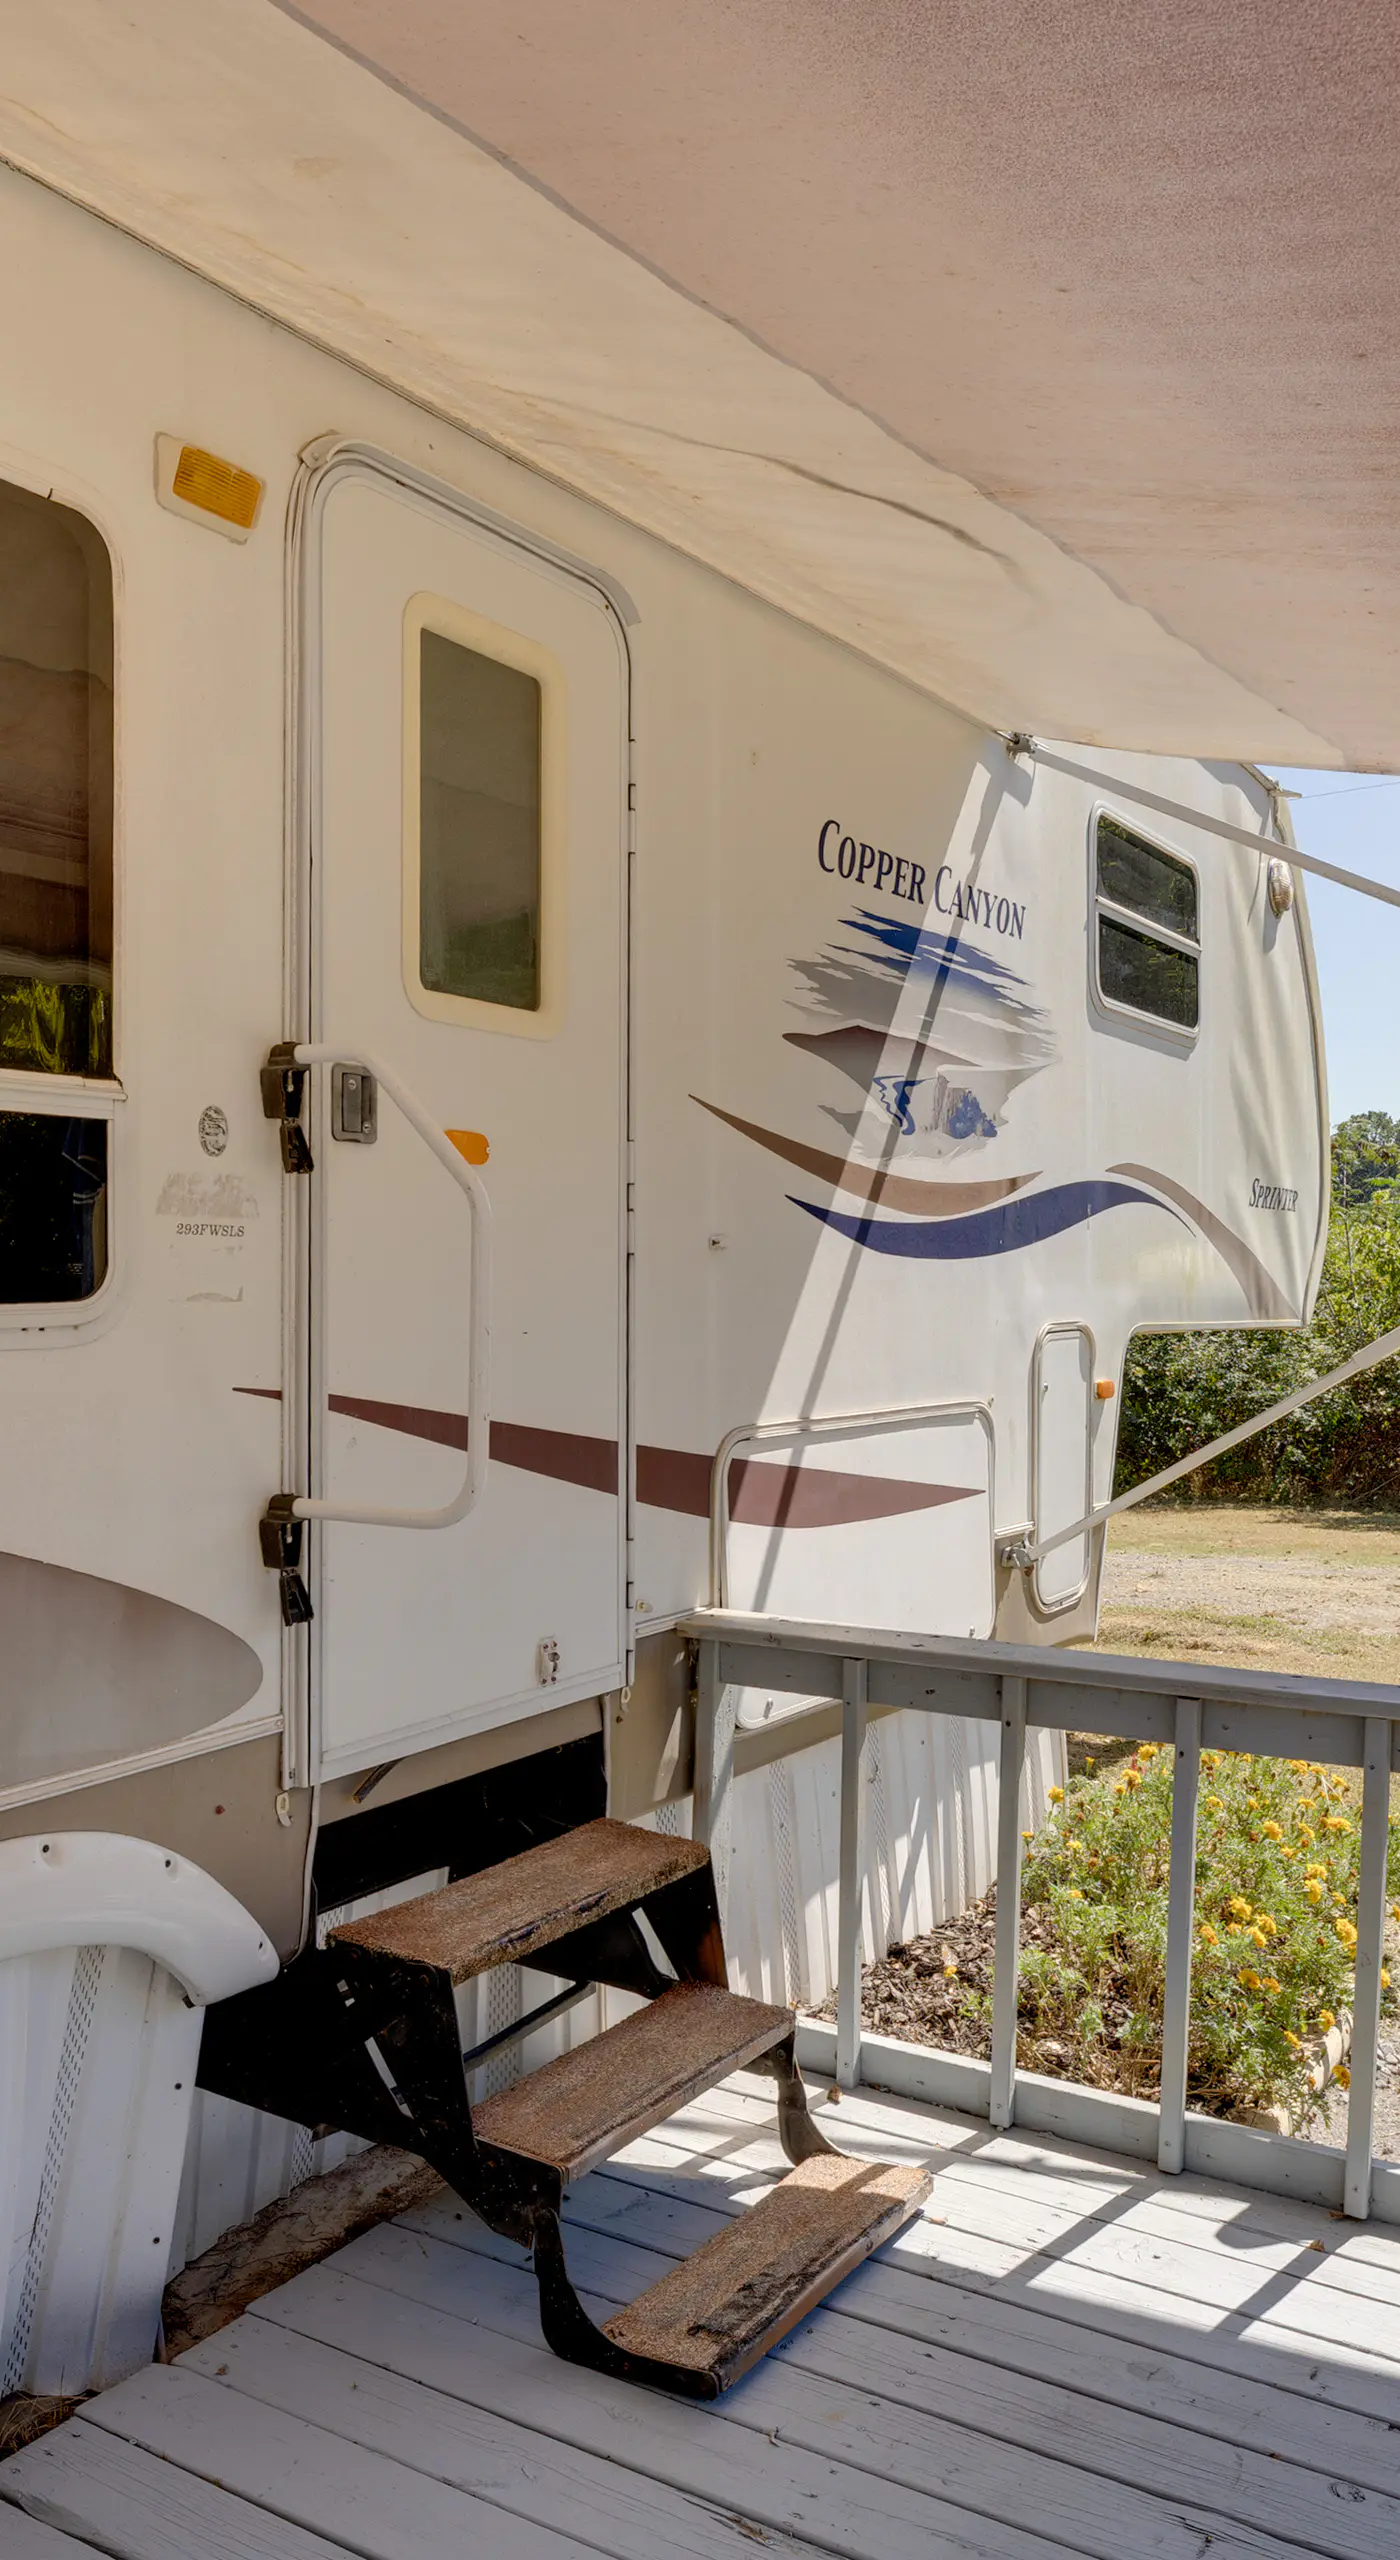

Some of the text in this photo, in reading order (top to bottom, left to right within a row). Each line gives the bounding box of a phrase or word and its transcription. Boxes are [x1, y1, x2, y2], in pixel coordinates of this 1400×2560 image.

[818, 819, 1026, 940] COPPER CANYON
[1249, 1178, 1299, 1212] SPRINTER
[176, 1222, 245, 1237] 293FWSLS
